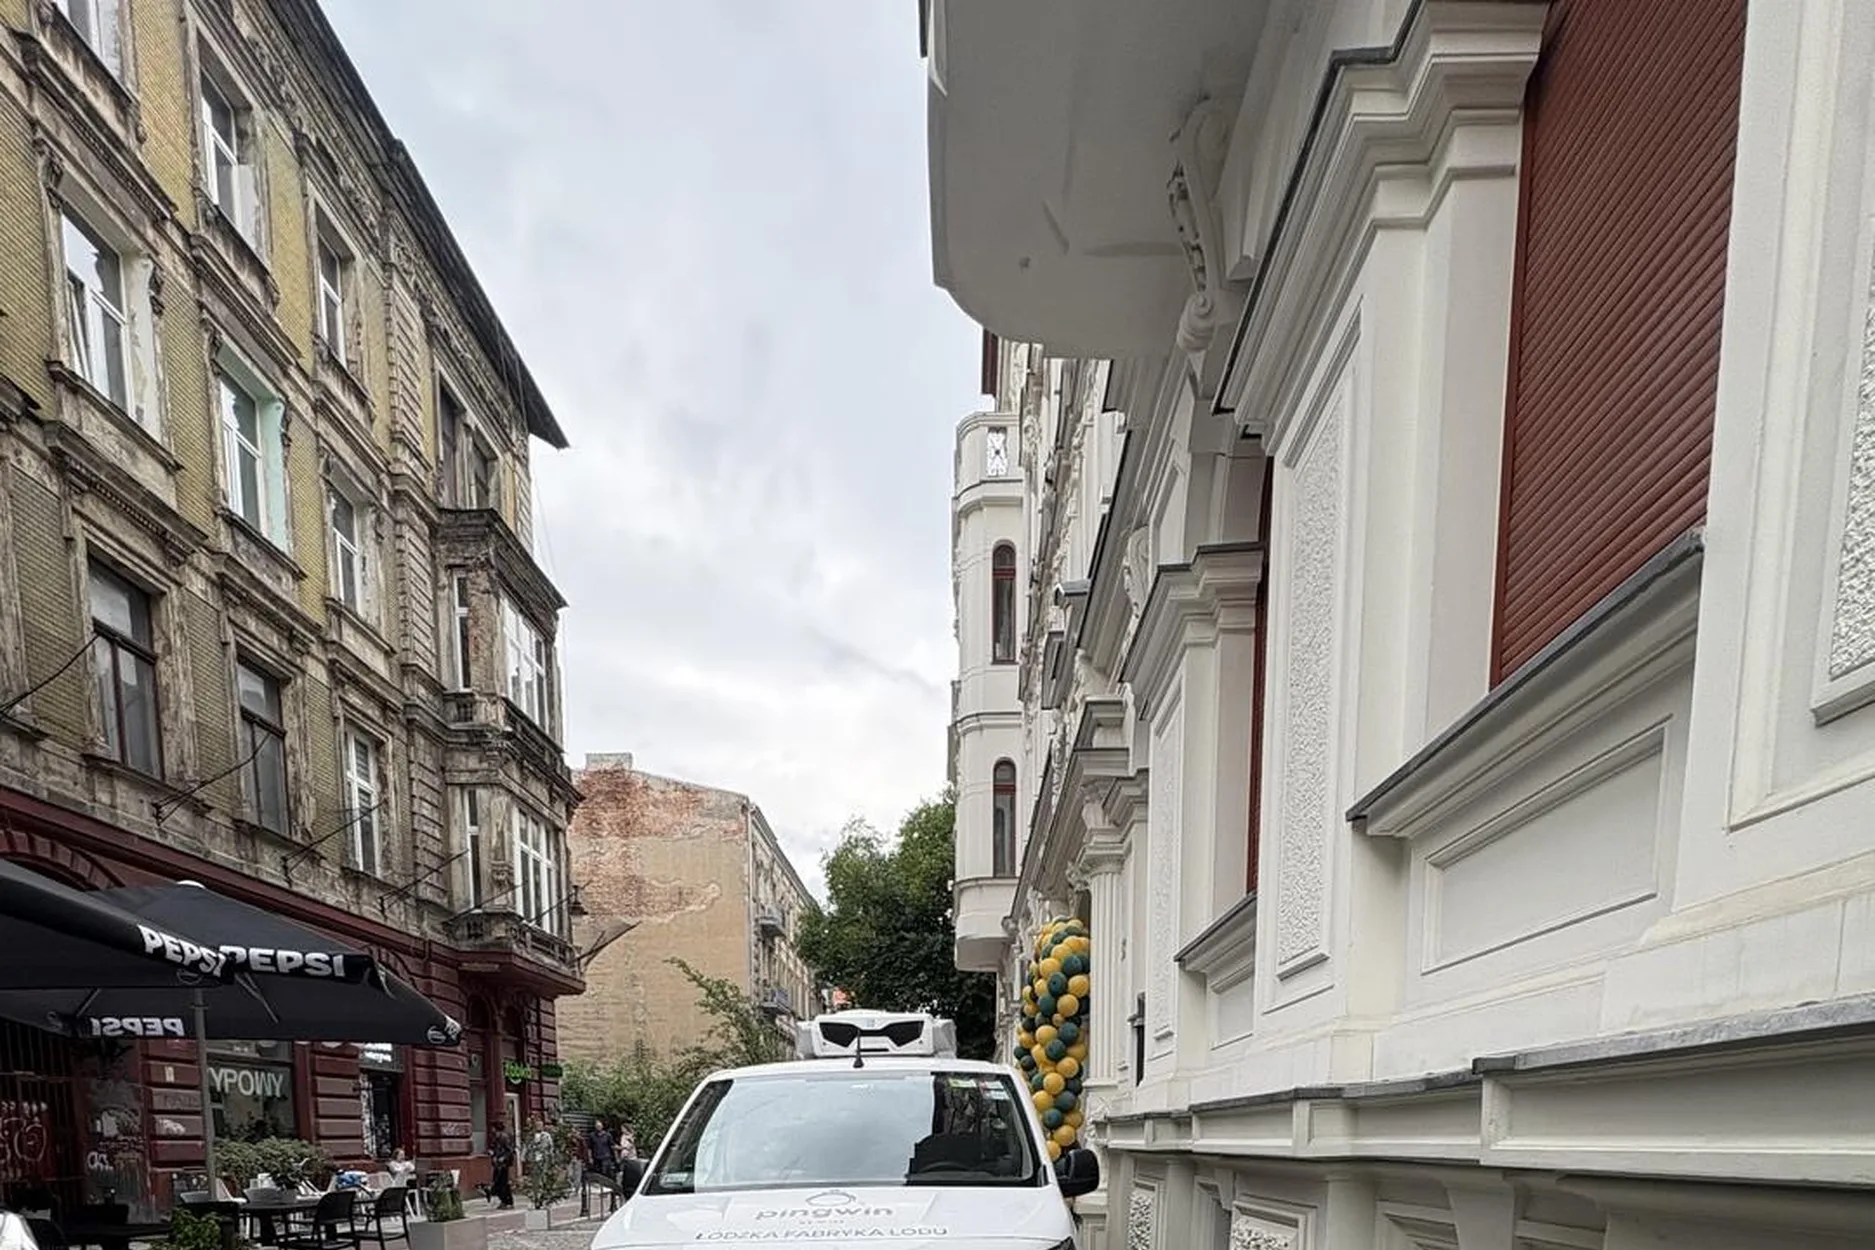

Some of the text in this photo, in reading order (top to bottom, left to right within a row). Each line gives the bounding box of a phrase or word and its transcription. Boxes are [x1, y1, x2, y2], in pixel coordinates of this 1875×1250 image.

[138, 924, 227, 977] PEPSI
[207, 1067, 283, 1097] YPOWY
[755, 1207, 894, 1220] pingwin
